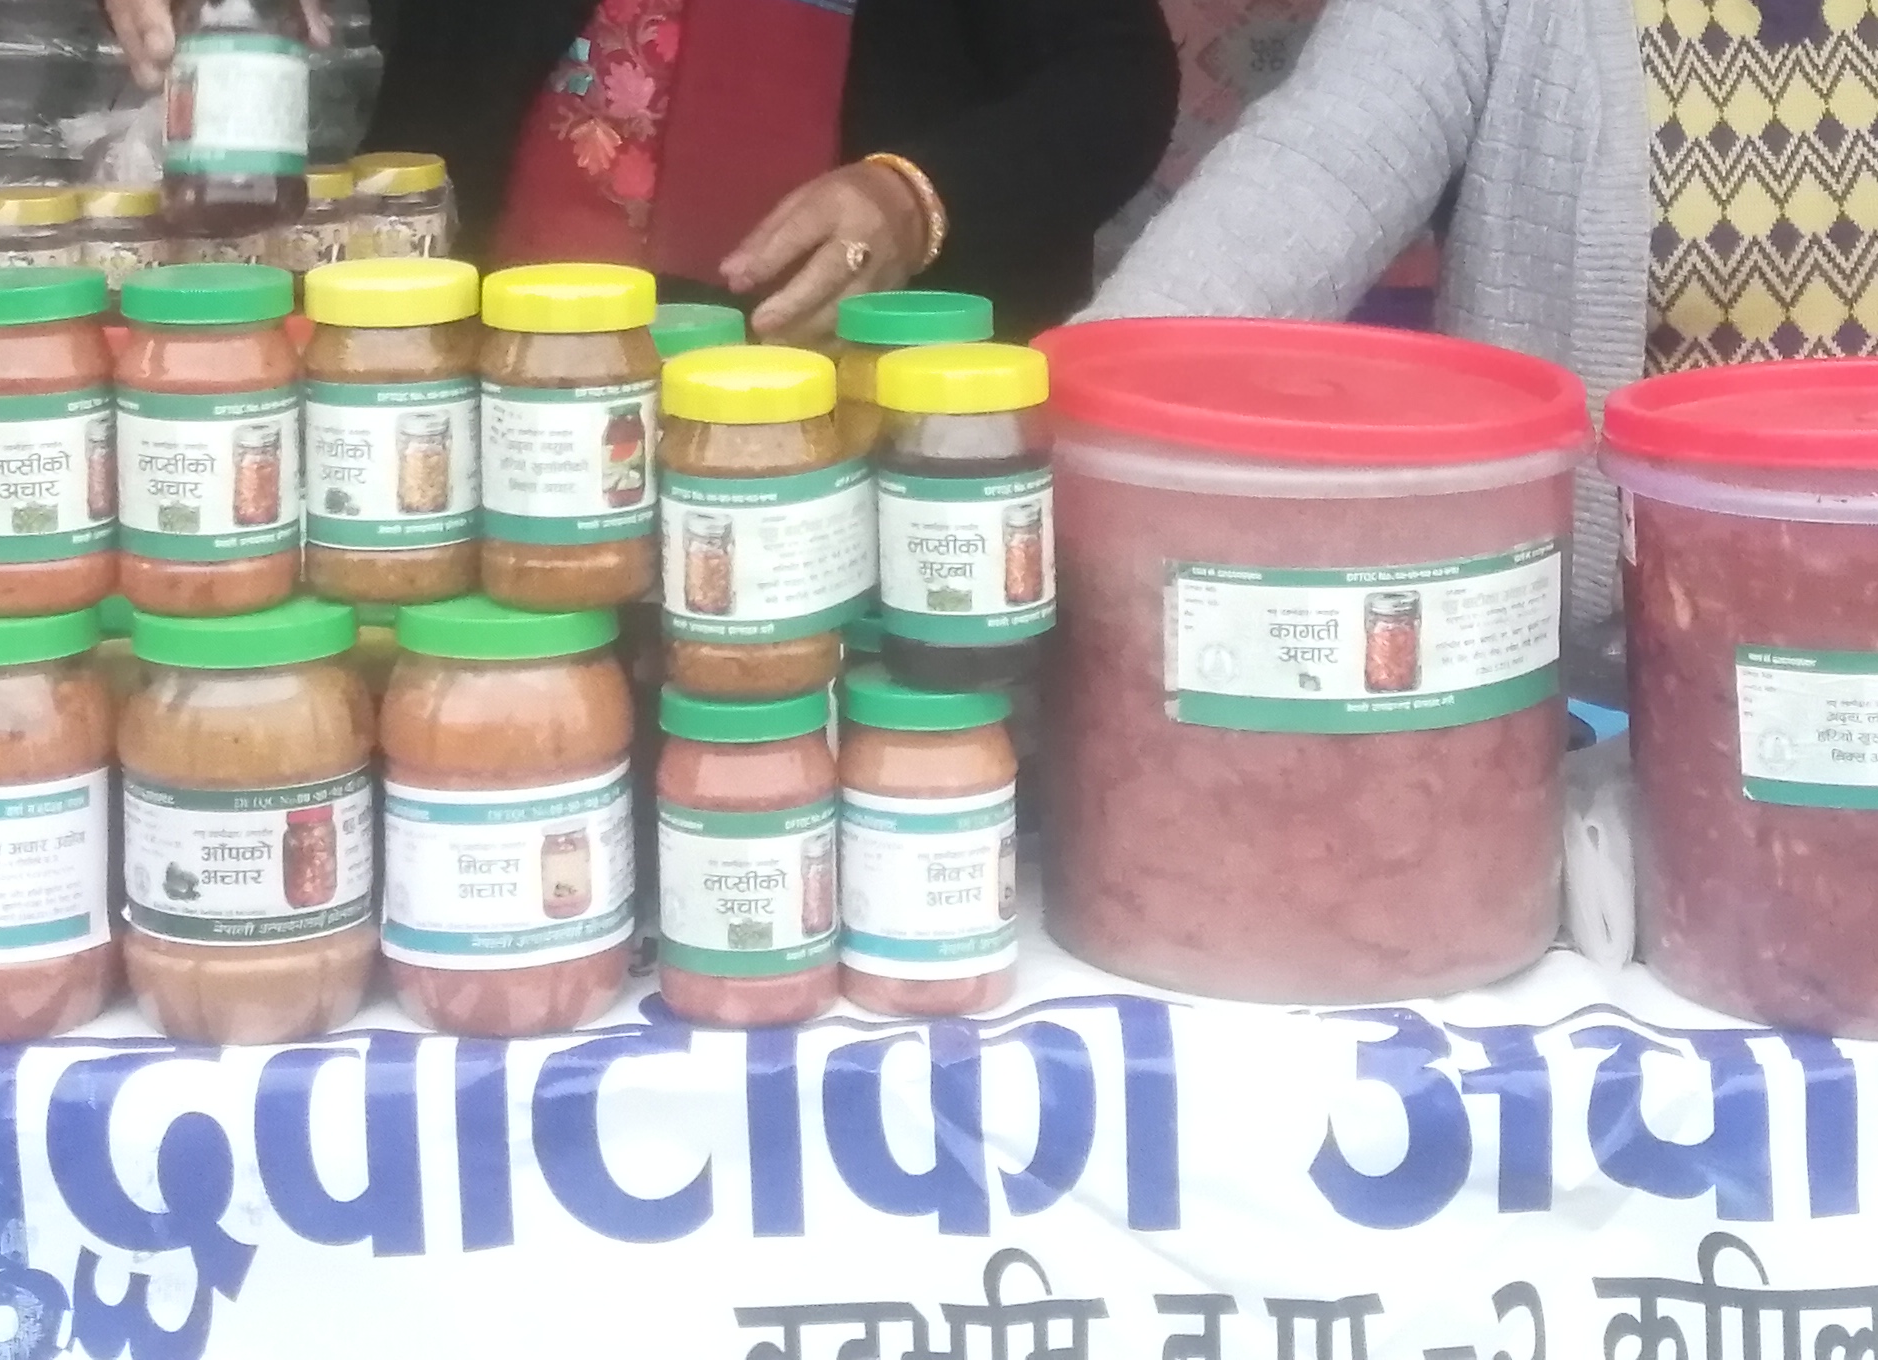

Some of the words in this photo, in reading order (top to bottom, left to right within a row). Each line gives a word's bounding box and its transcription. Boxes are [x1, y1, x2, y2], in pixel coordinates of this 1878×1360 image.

[138, 453, 216, 476] लप्सीको
[0, 480, 60, 500] अचार
[146, 478, 203, 499] अचार
[907, 533, 987, 556] लप्सीको
[1268, 618, 1340, 641] कागती
[1277, 646, 1340, 664] अचार
[200, 839, 273, 863] आँपको
[457, 853, 521, 876] मिक्स
[926, 862, 985, 883] मिक्स
[201, 868, 265, 887] अचार
[703, 868, 788, 893] लप्सीको
[457, 881, 518, 899] अचार
[925, 886, 983, 907] अचार
[716, 896, 775, 916] अचार
